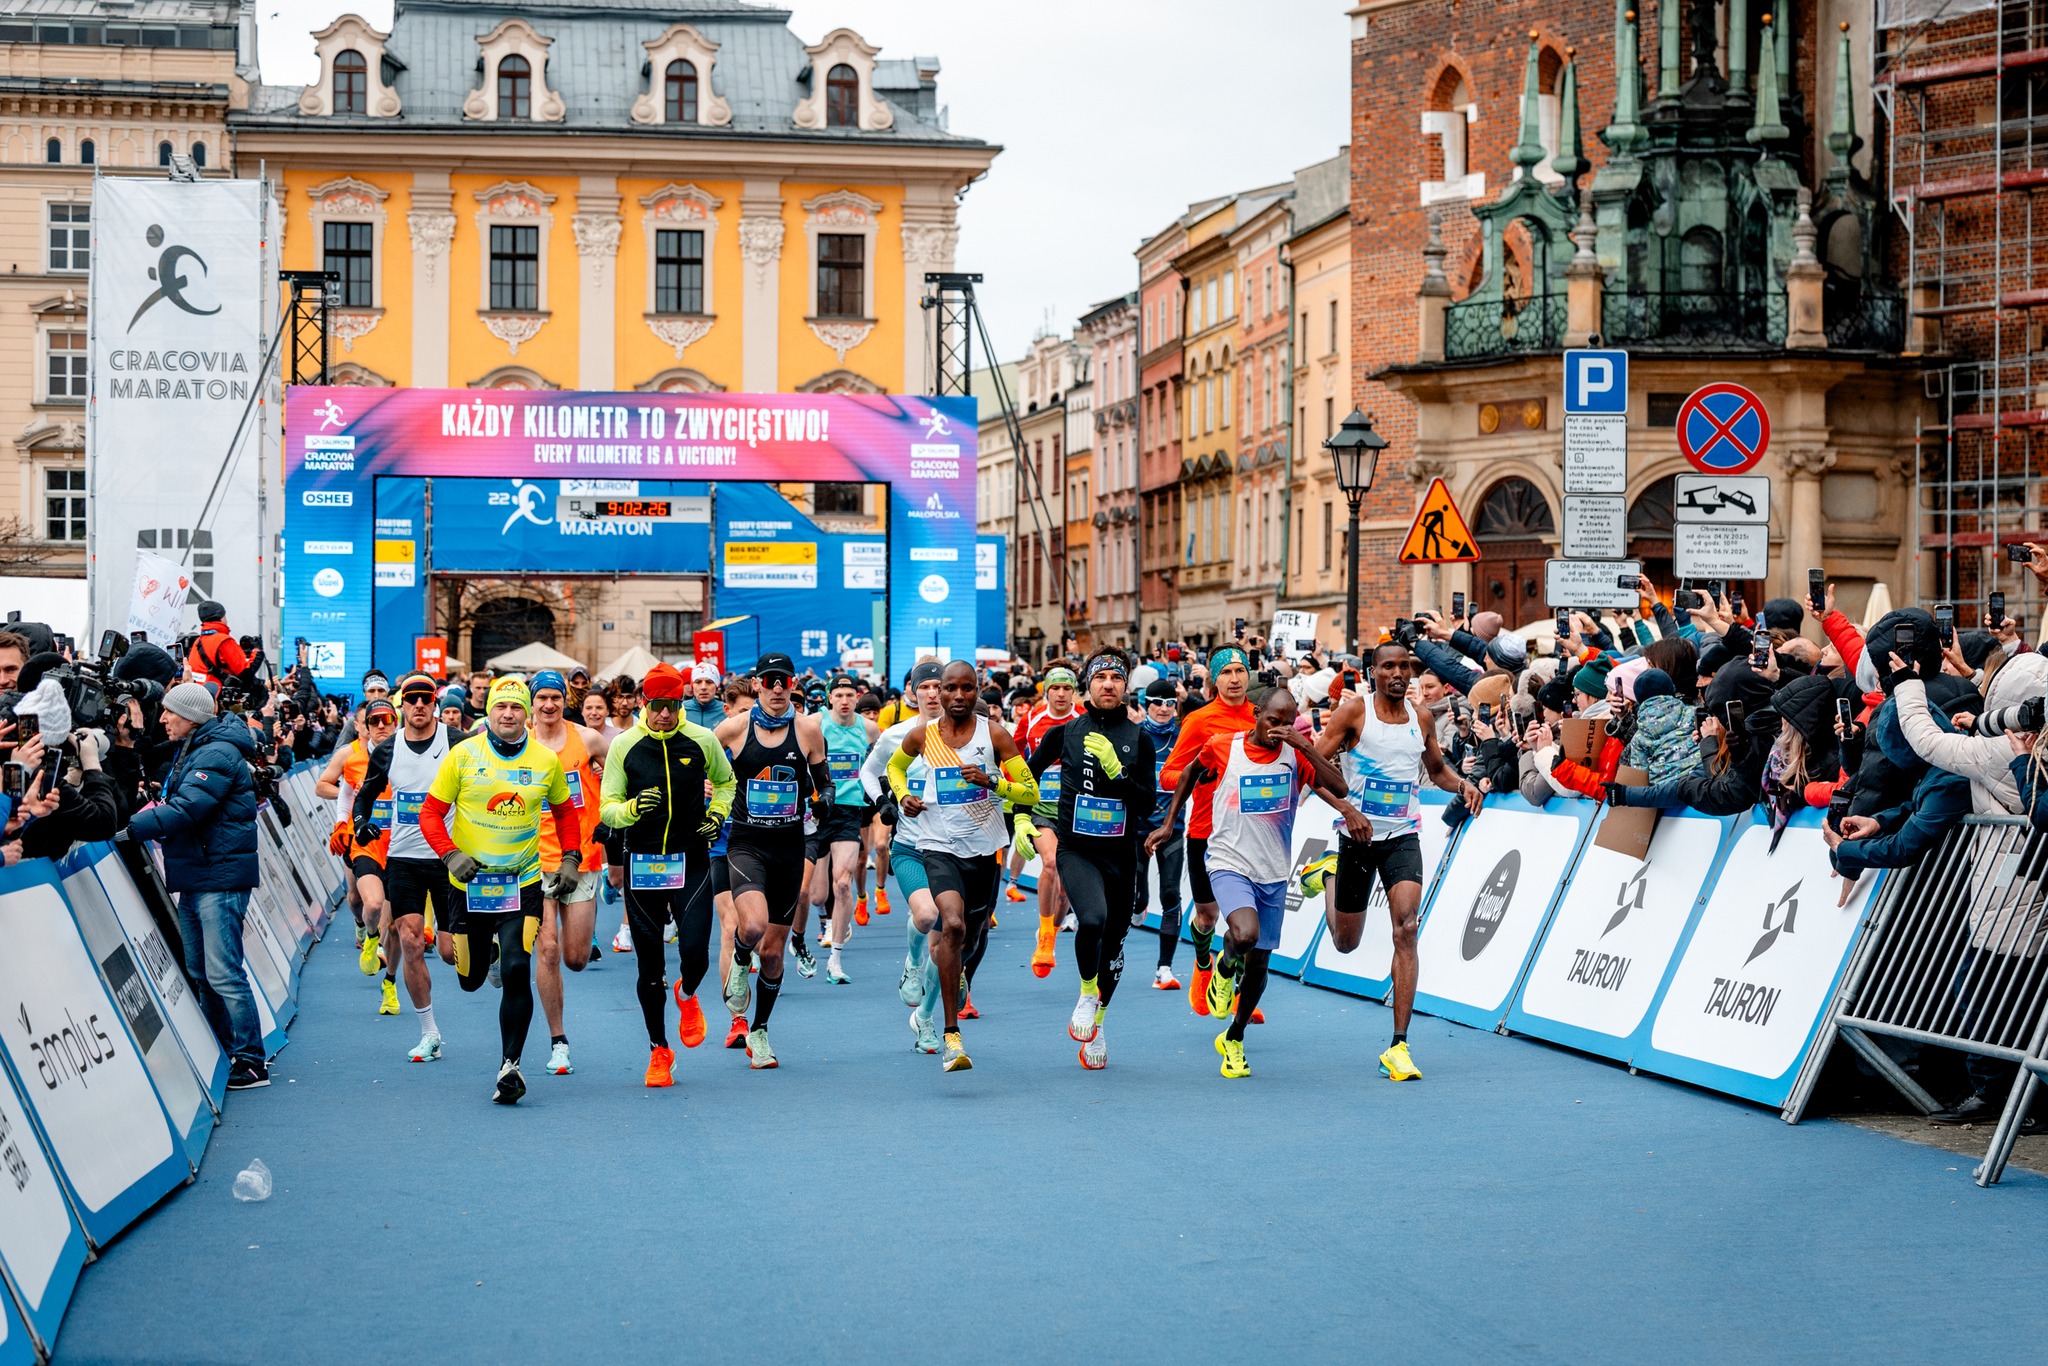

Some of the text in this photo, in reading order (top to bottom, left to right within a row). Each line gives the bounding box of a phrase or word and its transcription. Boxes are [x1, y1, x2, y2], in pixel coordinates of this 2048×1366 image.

[110, 350, 248, 373] CRACOVIA
[1578, 357, 1614, 406] P
[110, 379, 248, 400] MARATON
[442, 398, 829, 448] KAŻDY KILOMETR TO ZWYCIĘSTWO!
[304, 452, 355, 461] CRACOVIA
[534, 443, 736, 465] EVERY KILOMETRE IS A VICTORY!
[304, 461, 355, 471] MARATON
[911, 460, 960, 469] CRACOVIA
[911, 470, 959, 479] MARATON
[586, 481, 631, 491] TAURON
[306, 494, 350, 504] OSHEE
[487, 492, 510, 505] 22
[608, 501, 667, 516] 9:02.26
[907, 511, 960, 519] MAŁOPOLSKA
[560, 521, 653, 536] MARATON
[767, 793, 778, 803] 3
[1261, 787, 1273, 798] 6
[1383, 793, 1395, 803] 5
[1090, 809, 1112, 822] 113
[481, 886, 505, 896] 60
[1567, 948, 1632, 992] TAURON
[1703, 977, 1782, 1027] TAURON
[30, 1006, 115, 1090] amplus
